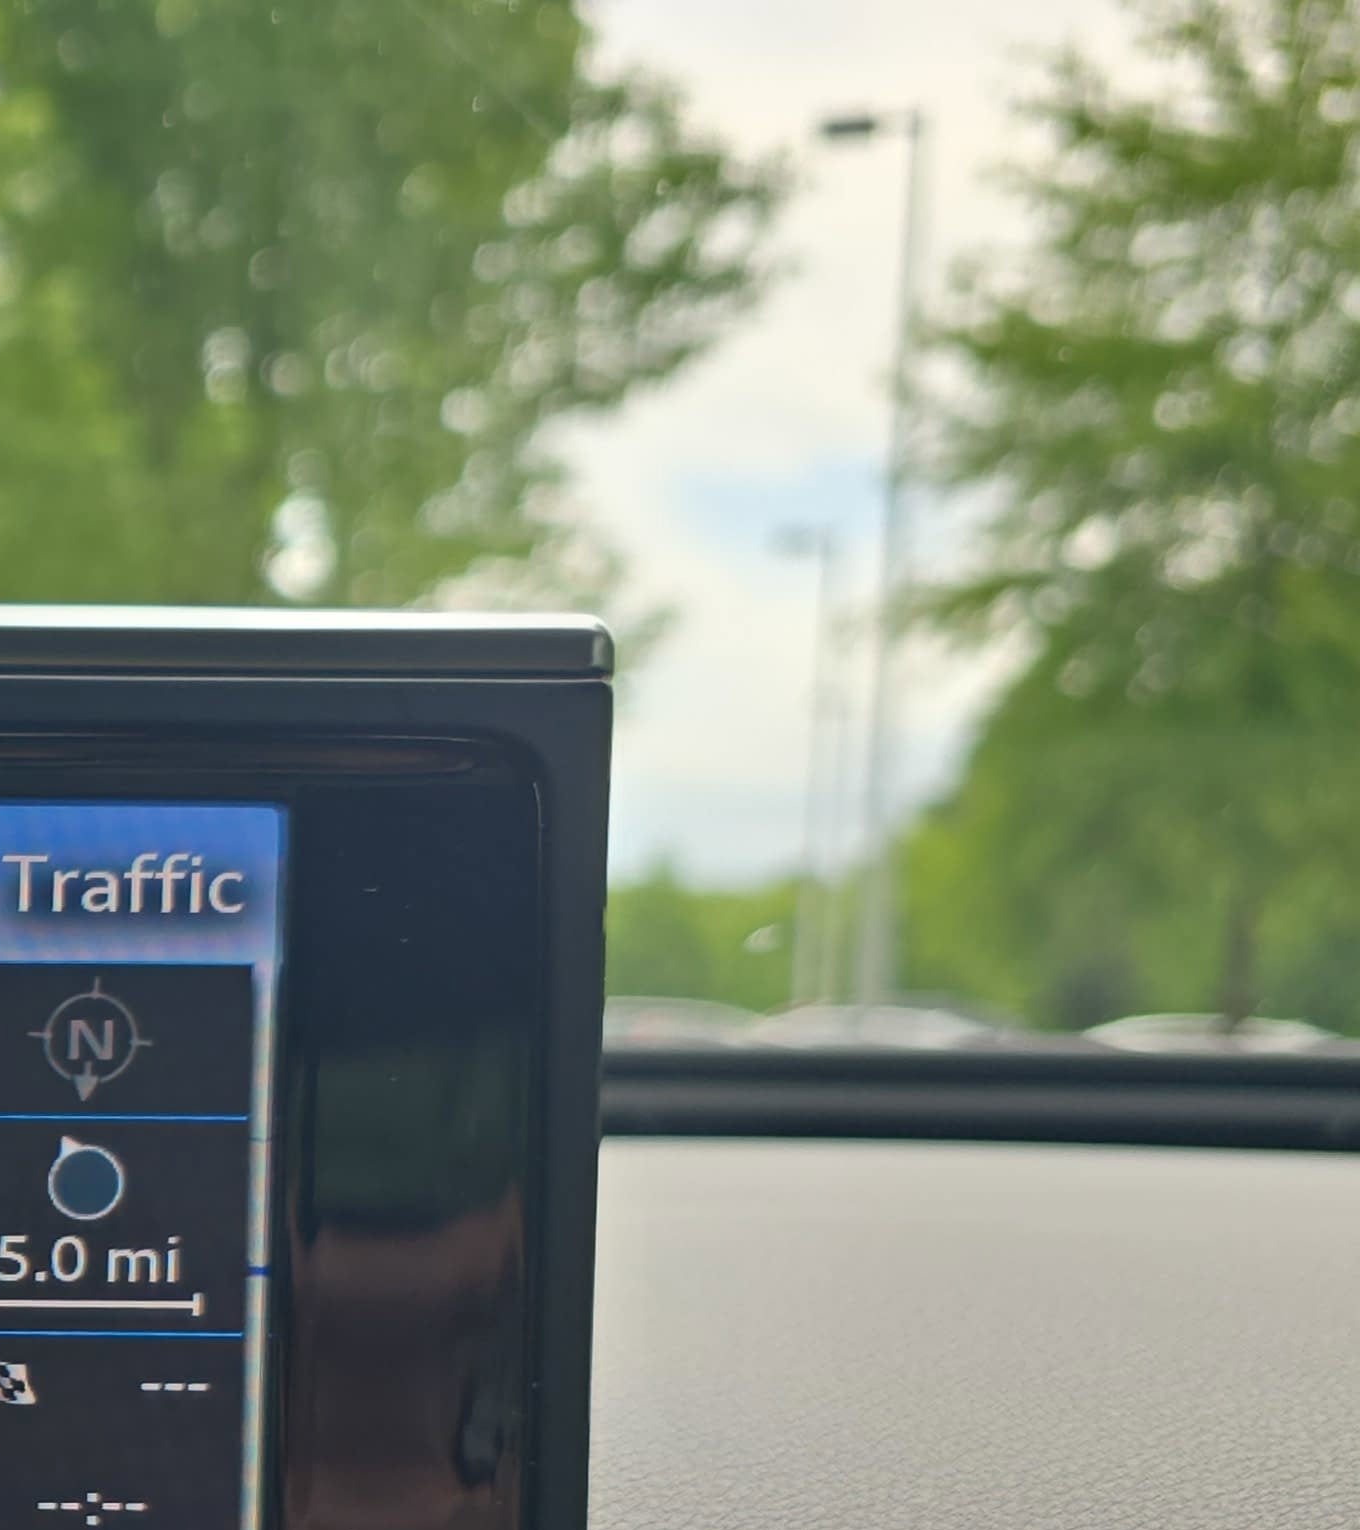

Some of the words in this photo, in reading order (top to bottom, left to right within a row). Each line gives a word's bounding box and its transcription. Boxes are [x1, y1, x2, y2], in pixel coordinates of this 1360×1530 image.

[2, 853, 244, 914] Traffic
[66, 1019, 115, 1061] N
[106, 1236, 181, 1284] mi
